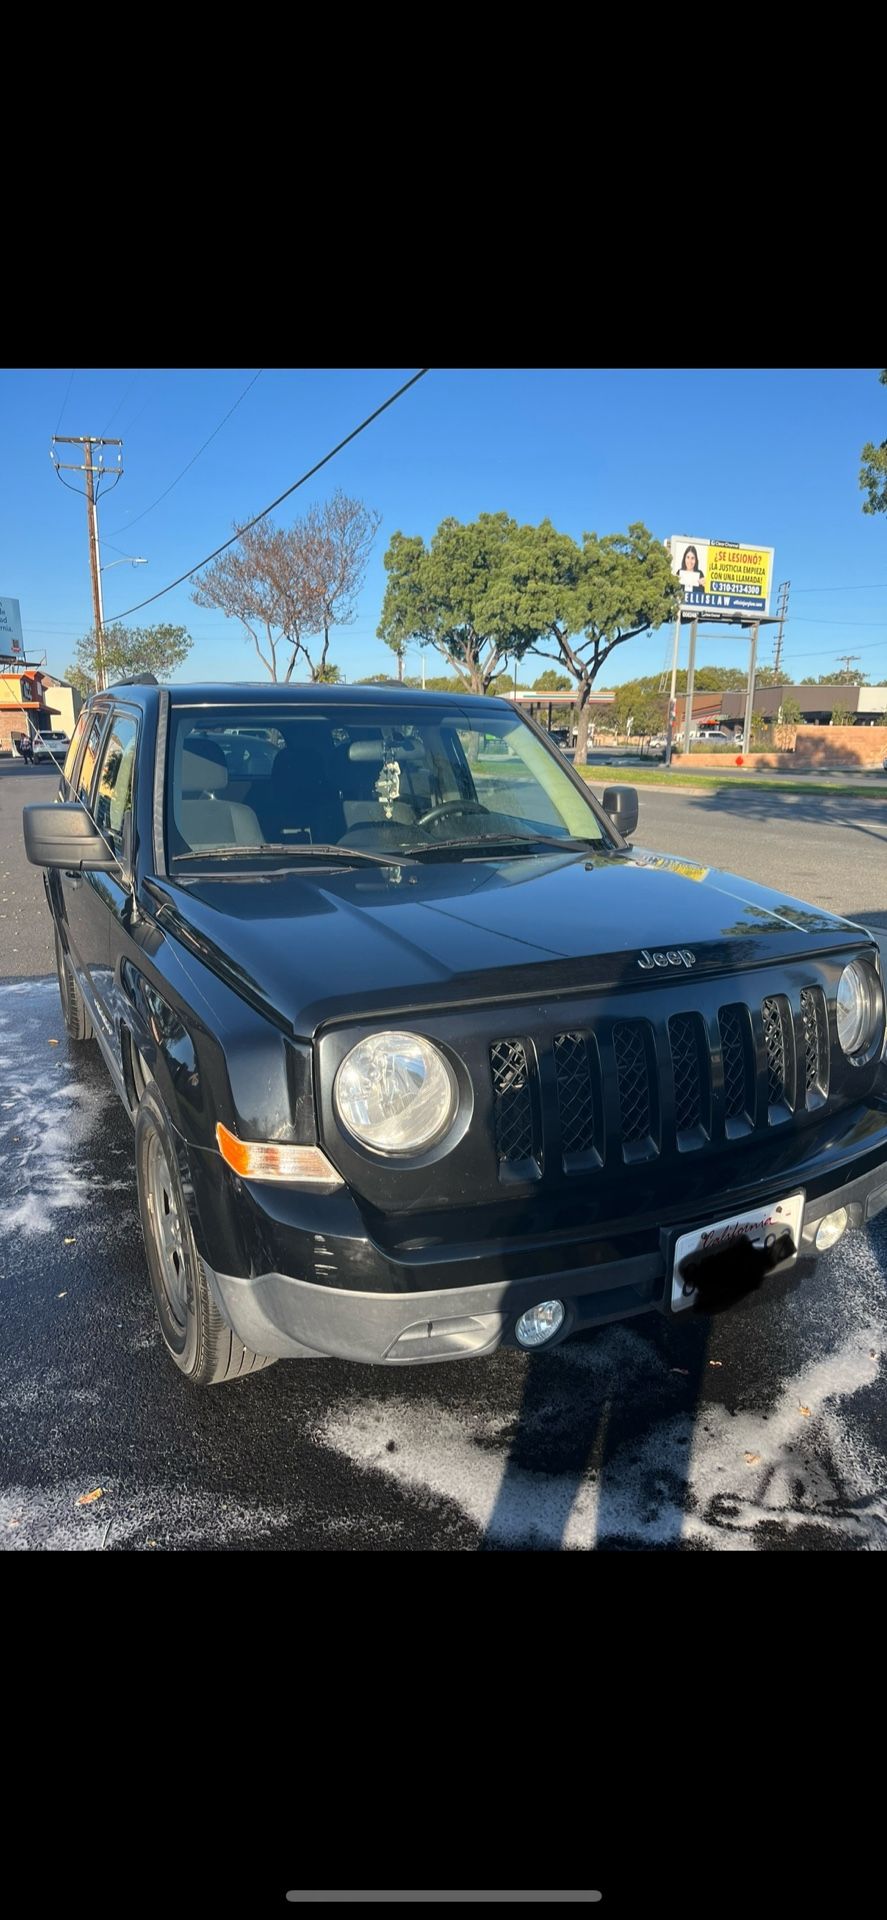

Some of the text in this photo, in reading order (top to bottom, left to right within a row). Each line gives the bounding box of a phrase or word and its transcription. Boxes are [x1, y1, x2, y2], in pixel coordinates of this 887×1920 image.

[714, 551, 762, 565] ¿SE LESIONÓ?
[719, 564, 742, 573] JUSTICIA
[743, 566, 765, 576] EMPIEZA
[711, 572, 763, 583] CON UNA LLAMADA!
[719, 585, 760, 594] 310-213-4300
[638, 950, 696, 969] Jeep
[701, 1214, 775, 1249] California
